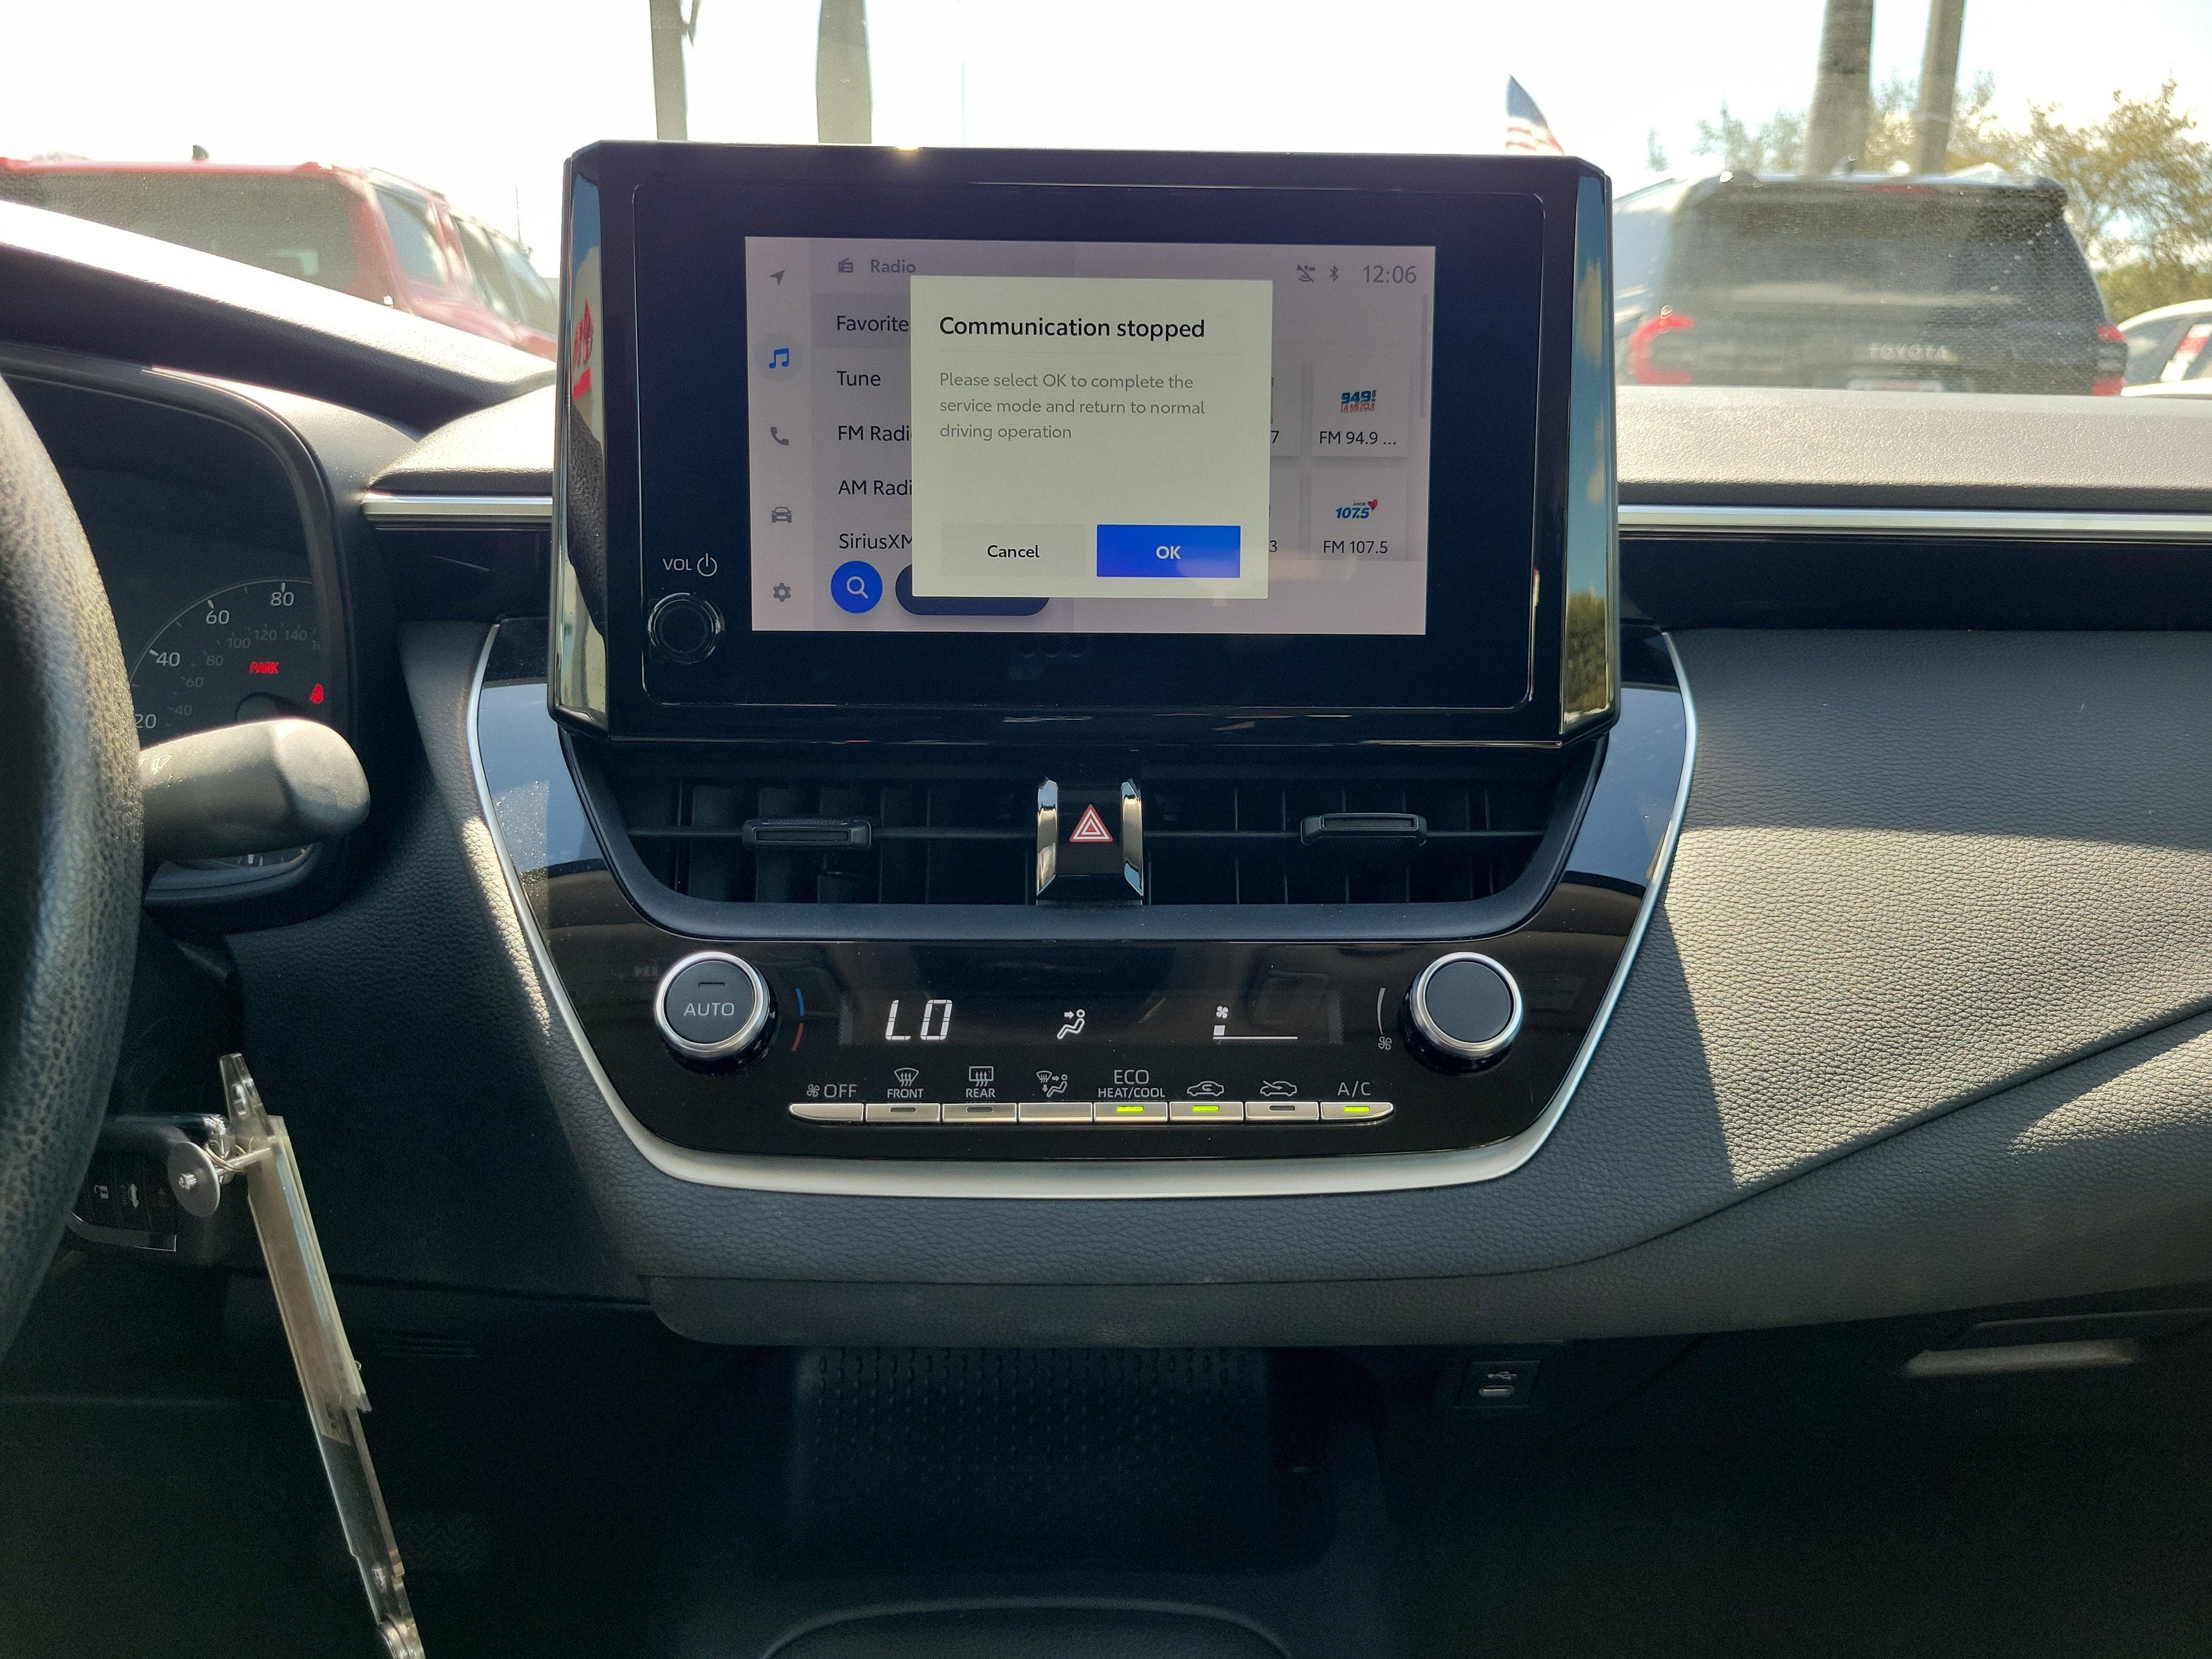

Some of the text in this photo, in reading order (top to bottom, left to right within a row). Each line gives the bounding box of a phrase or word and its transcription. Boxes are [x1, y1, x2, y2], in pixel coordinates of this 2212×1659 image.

[871, 259, 916, 273] Radio
[1364, 266, 1416, 284] 12:06
[837, 315, 911, 332] Favorite
[940, 317, 1204, 341] Communication stopped
[1868, 343, 1949, 360] TOYOTA
[837, 371, 881, 386] Tune
[941, 373, 1193, 391] Please select OK to complete the
[940, 399, 1205, 414] service mode and return to normal
[839, 425, 912, 441] FM Radi
[940, 424, 1071, 441] driving operation
[1320, 431, 1340, 444] FM
[1346, 432, 1378, 444] 94.9
[838, 479, 912, 495] AM Radi
[1336, 507, 1369, 519] 107.5
[839, 533, 912, 549] SiriusXM
[1324, 541, 1387, 554] FM 107.5
[988, 545, 1039, 557] Cancel
[1156, 546, 1181, 559] OK
[663, 558, 692, 570] VOL
[270, 592, 295, 606] 80
[206, 610, 230, 624] 60
[254, 630, 277, 641] 120
[285, 630, 307, 641] 140
[228, 638, 251, 648] 100
[156, 652, 180, 667] 40
[206, 656, 223, 666] 80
[250, 662, 279, 674] PARK
[186, 677, 204, 687] 60
[174, 705, 192, 715] 40
[135, 714, 157, 729] 20
[684, 1002, 735, 1016] AUTO
[1114, 1070, 1149, 1084] ECO
[824, 1084, 857, 1098] OFF
[887, 1088, 924, 1098] FRONT
[966, 1088, 996, 1098] REAR
[1098, 1087, 1165, 1098] HEAT/COOL
[1338, 1081, 1371, 1097] A/C
